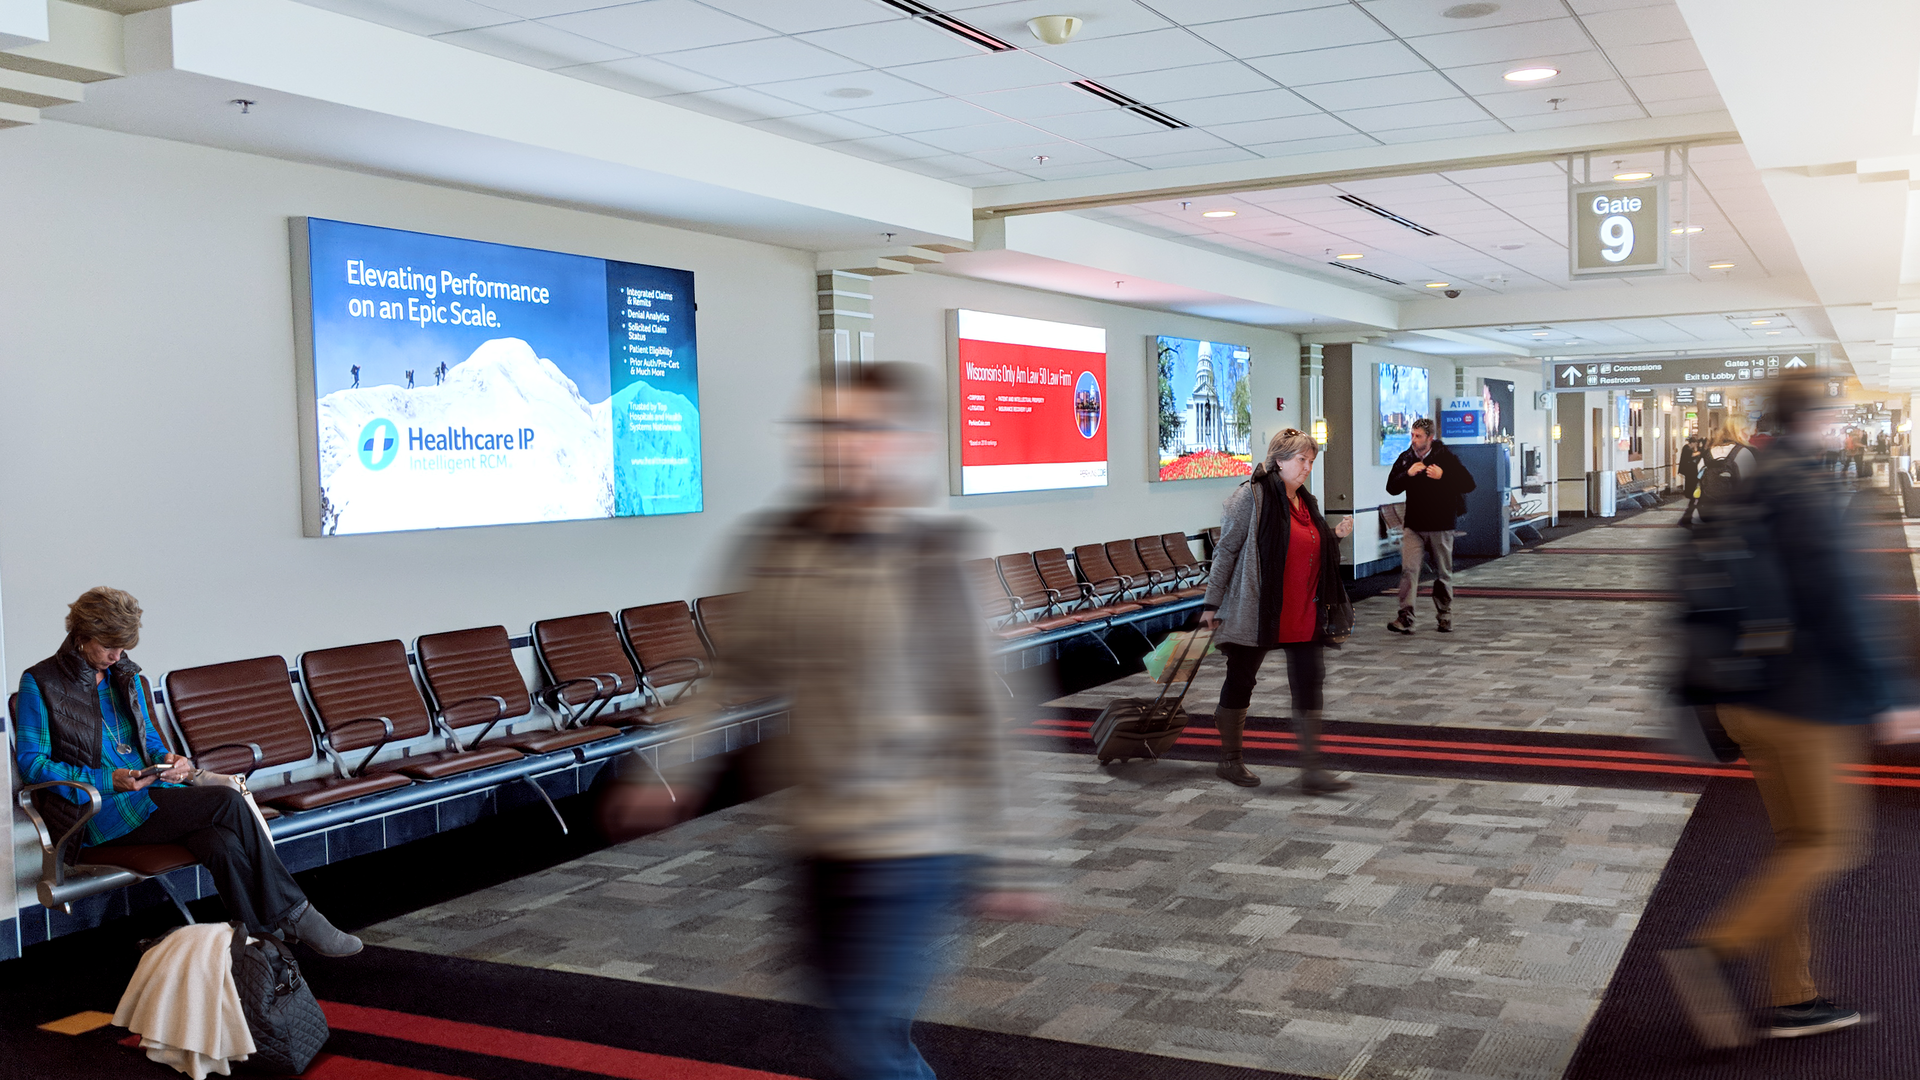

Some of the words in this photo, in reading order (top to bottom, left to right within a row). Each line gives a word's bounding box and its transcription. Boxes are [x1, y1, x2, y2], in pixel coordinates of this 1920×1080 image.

[1592, 195, 1642, 215] Gate
[1600, 215, 1635, 262] 9
[347, 259, 437, 299] Elevating
[441, 270, 550, 304] Performance
[626, 287, 654, 299] Integrated
[655, 290, 673, 301] Claims
[627, 297, 632, 305] &
[633, 297, 651, 307] Remits
[349, 298, 374, 318] on
[379, 301, 403, 320] an
[408, 297, 447, 328] Epic
[451, 301, 501, 328] Scale.
[627, 309, 645, 319] Denial
[646, 311, 670, 323] Analytics
[628, 322, 651, 333] Solicited
[652, 324, 667, 334] Claim
[628, 332, 646, 341] Status
[629, 344, 648, 354] Patient
[649, 346, 673, 358] Eligibility
[630, 358, 643, 366] Prior
[643, 358, 680, 369] Auth/Pre-Cert
[1613, 364, 1662, 372] Concessions
[630, 367, 635, 375] &
[636, 367, 651, 376] Much
[651, 368, 665, 377] More
[966, 361, 1002, 382] Wisconsin's
[1002, 364, 1015, 387] Only
[1016, 366, 1026, 383] Am
[1027, 367, 1039, 384] Law
[1040, 367, 1046, 384] 50
[1047, 368, 1058, 385] Law
[1684, 373, 1700, 381] Exit
[1711, 372, 1735, 380] Lobby
[1600, 376, 1640, 384] Restrooms
[1829, 386, 1838, 396] 8
[629, 402, 649, 411] Trusted
[651, 402, 657, 413] by
[655, 413, 664, 421] and
[629, 422, 652, 433] Systems
[409, 426, 514, 451] Healthcare
[518, 427, 535, 450] IP
[410, 455, 476, 474] Intelligent
[480, 454, 507, 469] RCM
